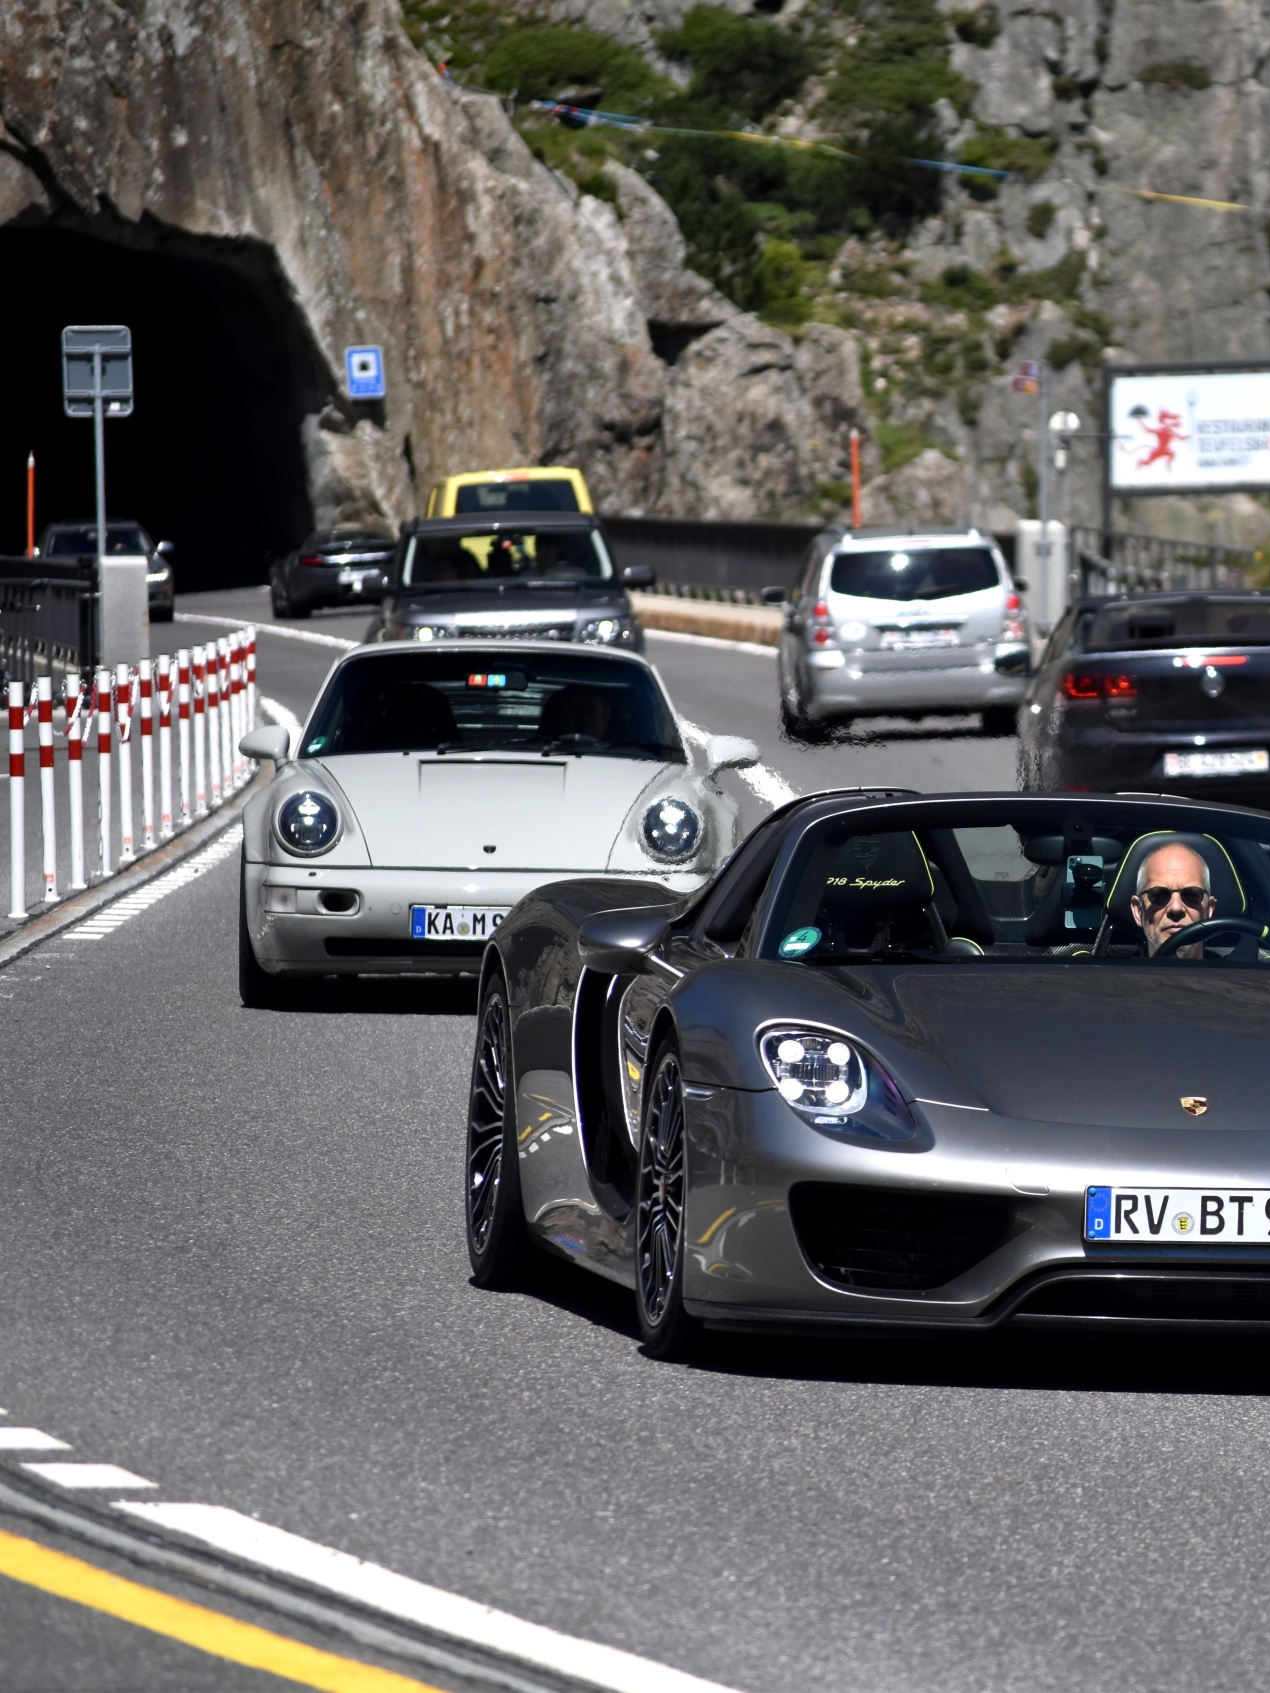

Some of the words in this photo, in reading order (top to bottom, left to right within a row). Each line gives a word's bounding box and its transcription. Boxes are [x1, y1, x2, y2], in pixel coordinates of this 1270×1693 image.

[849, 877, 905, 890] Spyder
[427, 911, 455, 935] KA
[797, 930, 810, 943] 4
[1094, 1218, 1104, 1230] D
[1115, 1194, 1170, 1235] RV
[1200, 1195, 1254, 1236] BT
